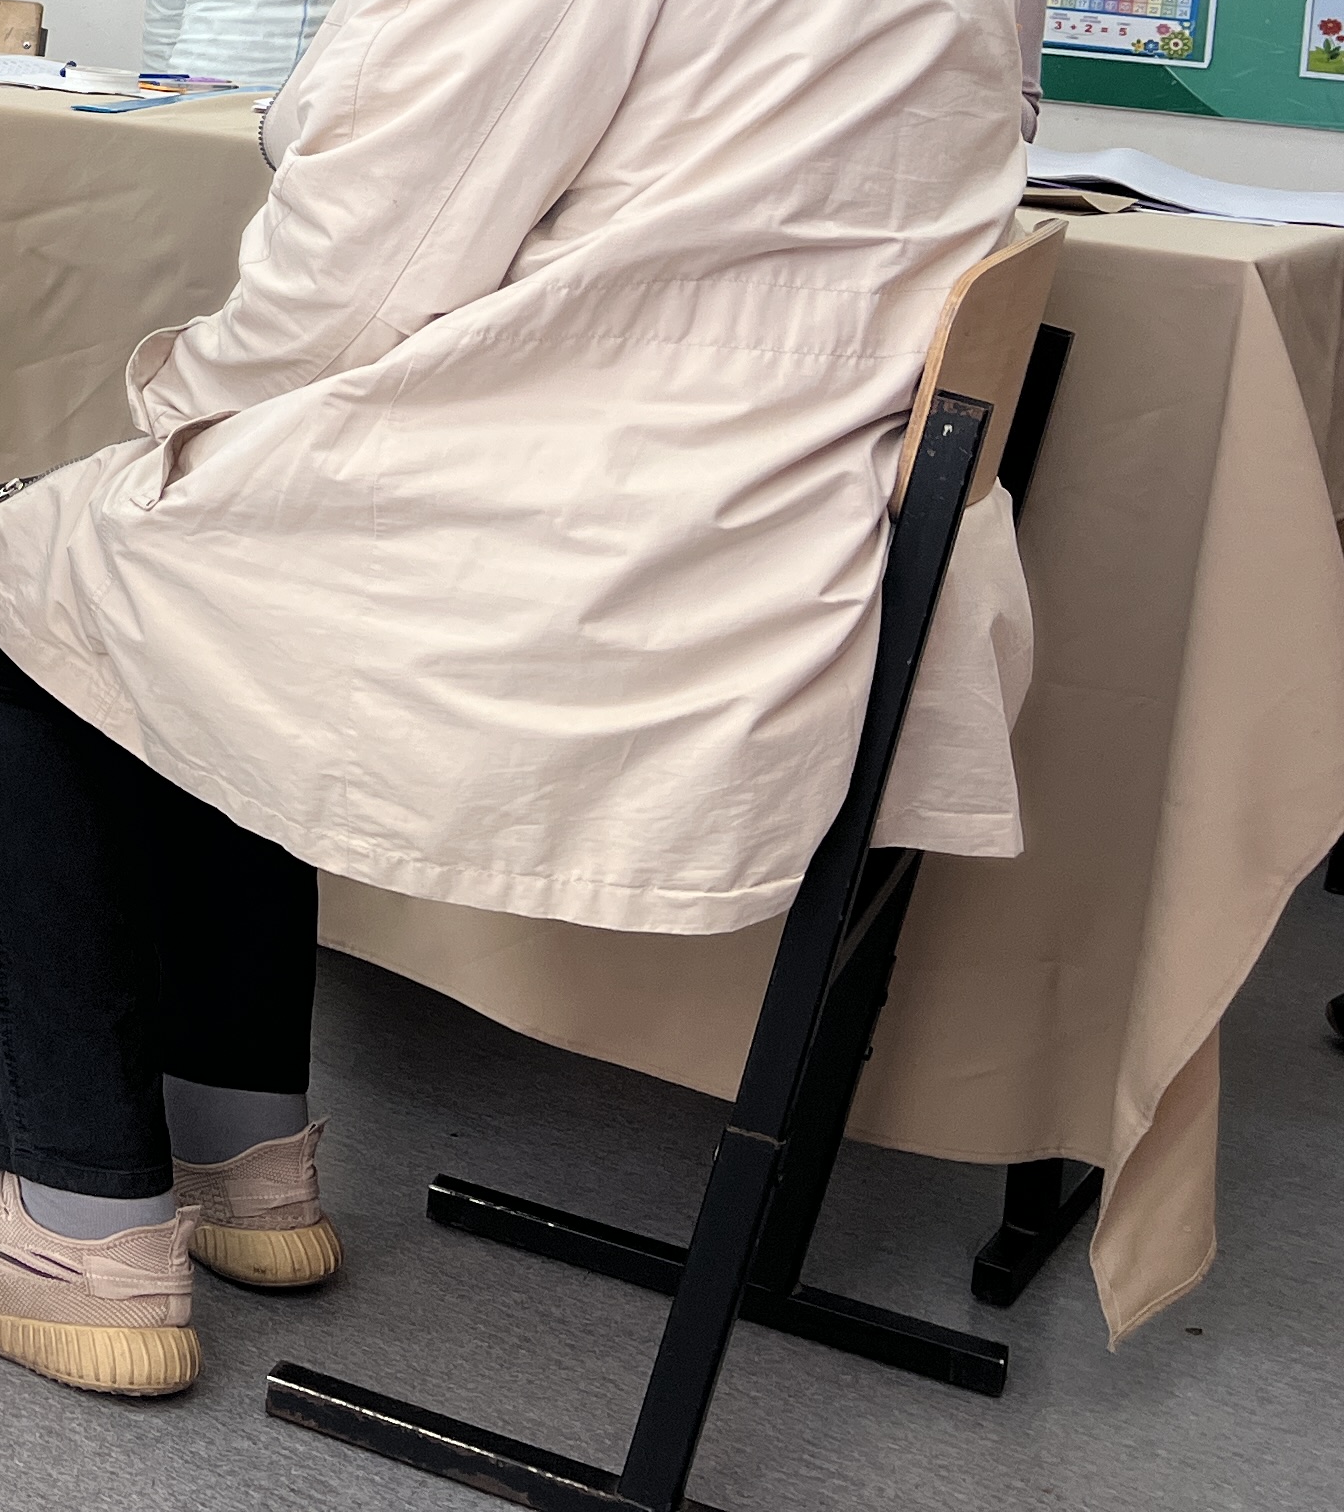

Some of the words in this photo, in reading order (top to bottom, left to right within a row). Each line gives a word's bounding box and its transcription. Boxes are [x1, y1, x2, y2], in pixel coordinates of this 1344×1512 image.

[1054, 21, 1062, 30] 3
[1084, 24, 1093, 33] 2
[1119, 27, 1127, 36] 5
